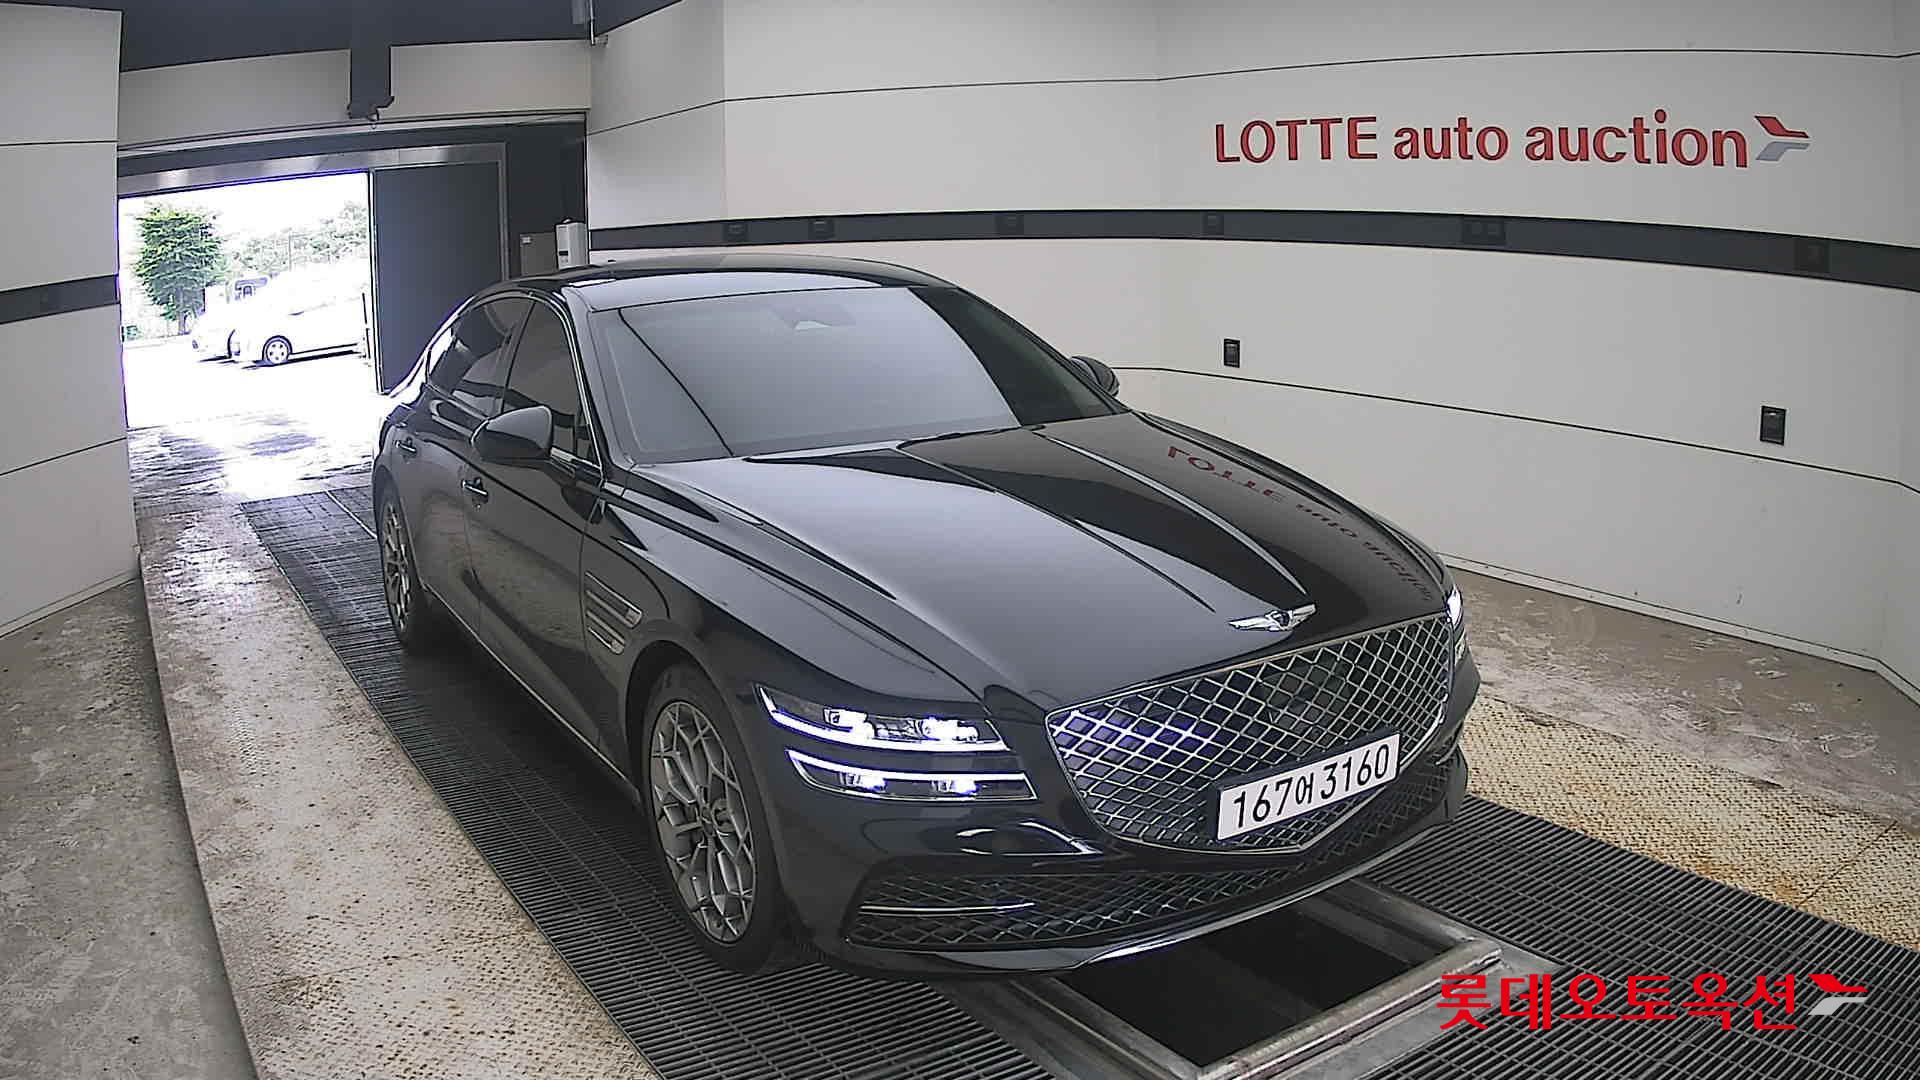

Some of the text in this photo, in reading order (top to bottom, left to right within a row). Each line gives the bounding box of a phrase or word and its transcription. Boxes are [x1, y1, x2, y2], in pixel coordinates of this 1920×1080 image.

[1214, 108, 1749, 169] LOTTE auto auction
[1233, 743, 1391, 829] 167어 3160
